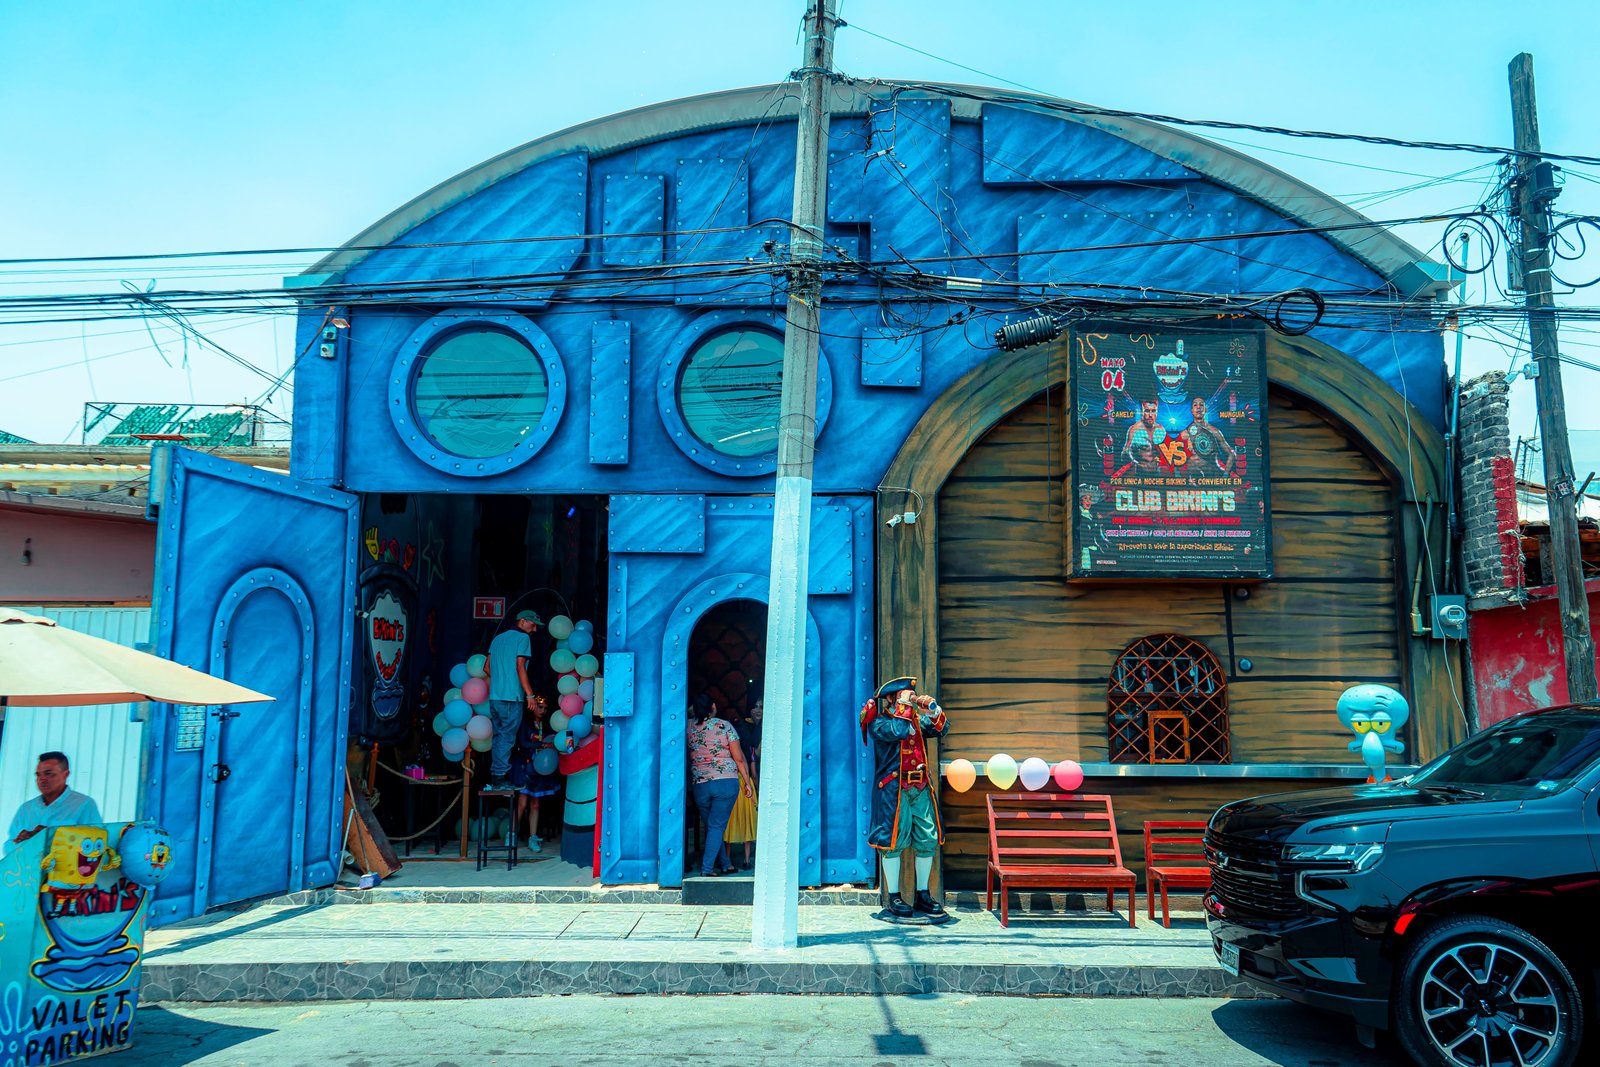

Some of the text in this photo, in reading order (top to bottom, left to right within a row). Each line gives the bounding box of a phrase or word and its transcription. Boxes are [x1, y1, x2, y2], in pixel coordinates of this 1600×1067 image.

[1101, 357, 1125, 367] MAYO
[1101, 370, 1125, 391] 04
[1159, 440, 1187, 466] VS
[1115, 490, 1236, 511] CLUB BIKINI'S
[32, 990, 130, 1031] VALET
[25, 1021, 129, 1066] PARKING
